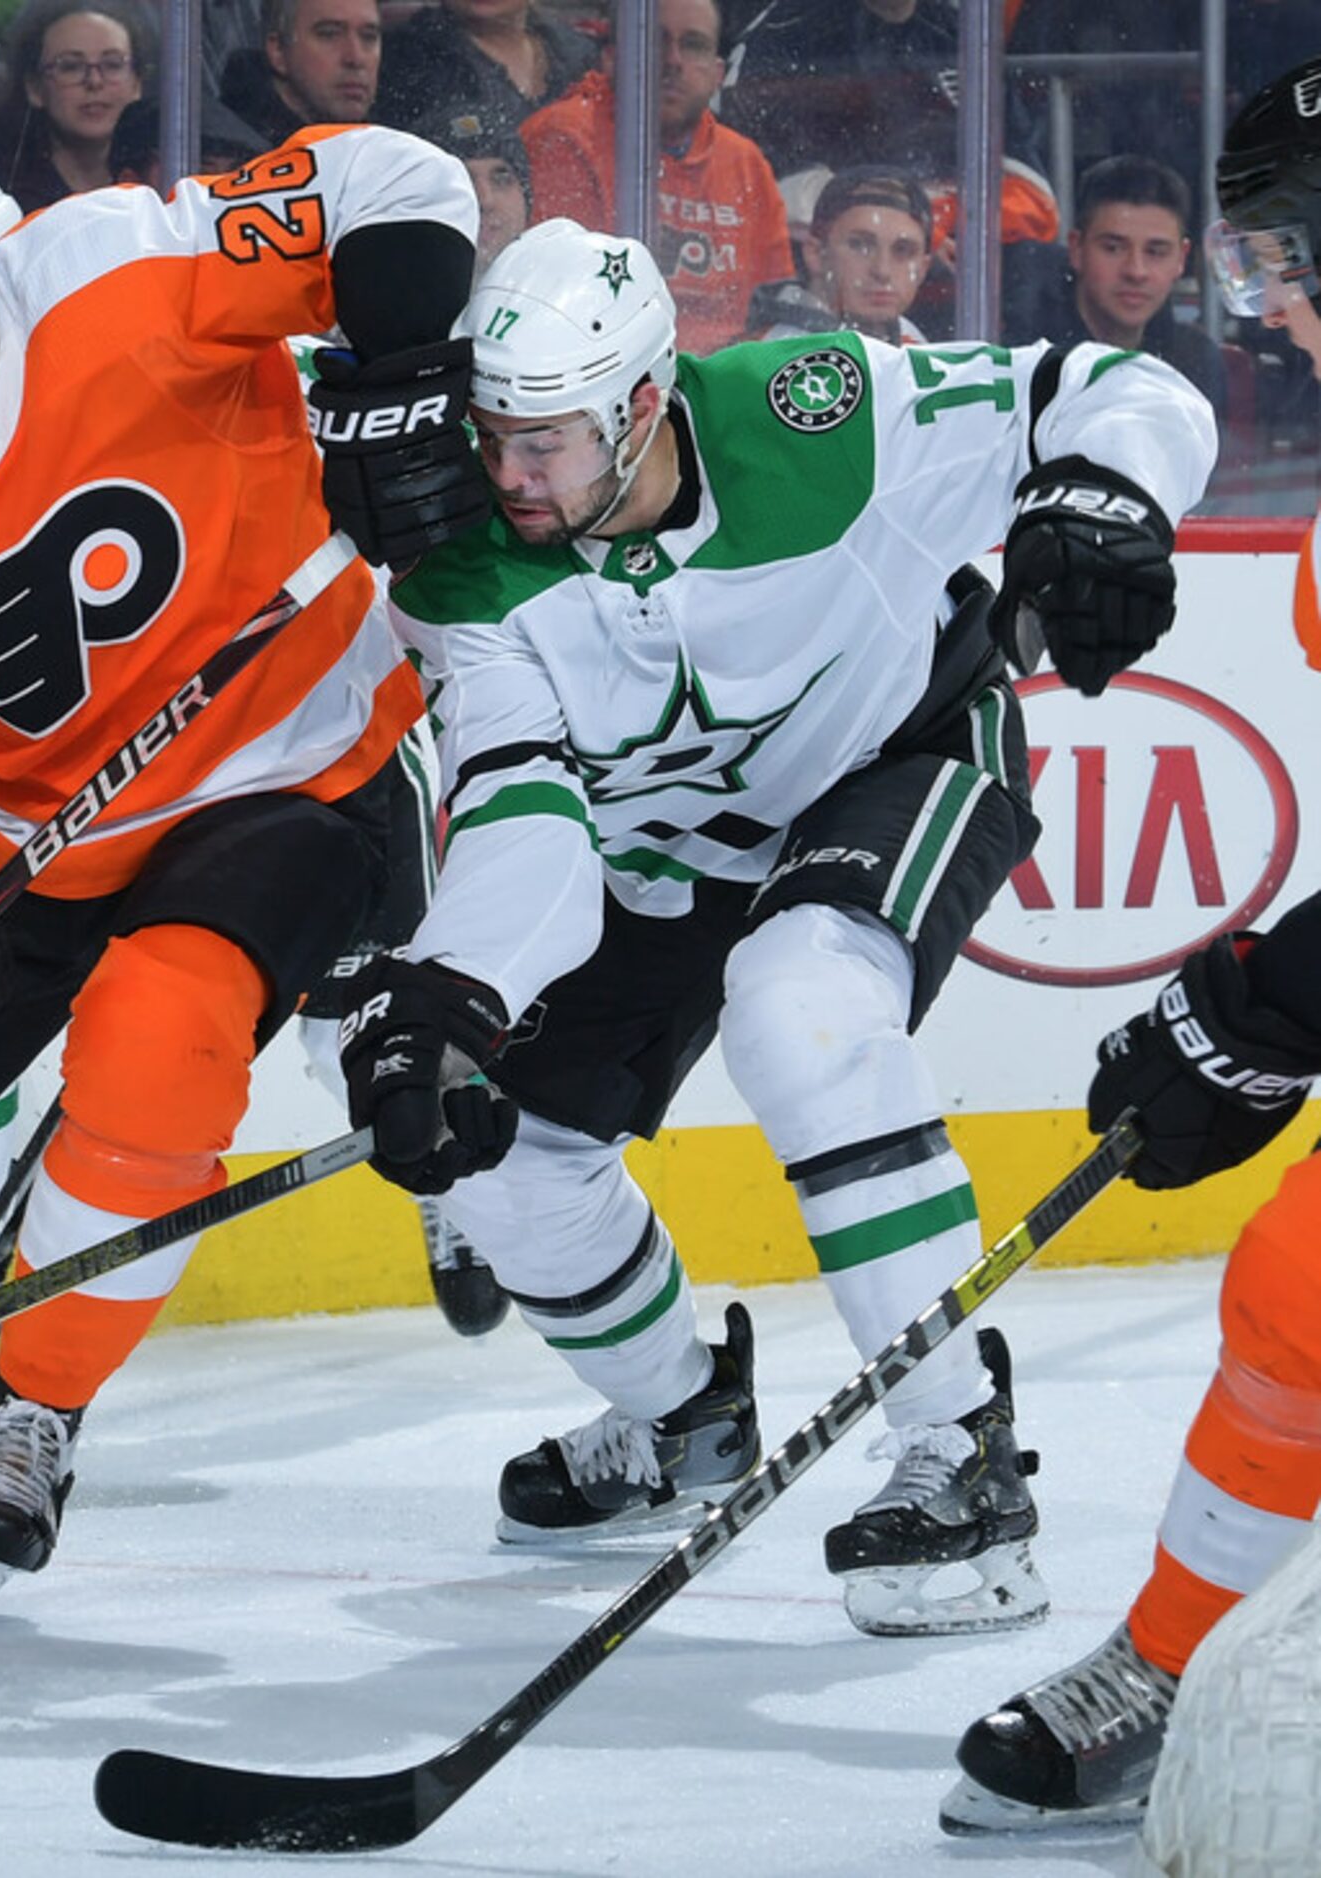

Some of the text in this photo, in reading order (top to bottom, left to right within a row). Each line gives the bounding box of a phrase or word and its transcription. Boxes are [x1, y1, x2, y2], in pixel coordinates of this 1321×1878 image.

[208, 146, 327, 266] 26
[484, 305, 521, 342] 17
[907, 345, 1016, 426] 17
